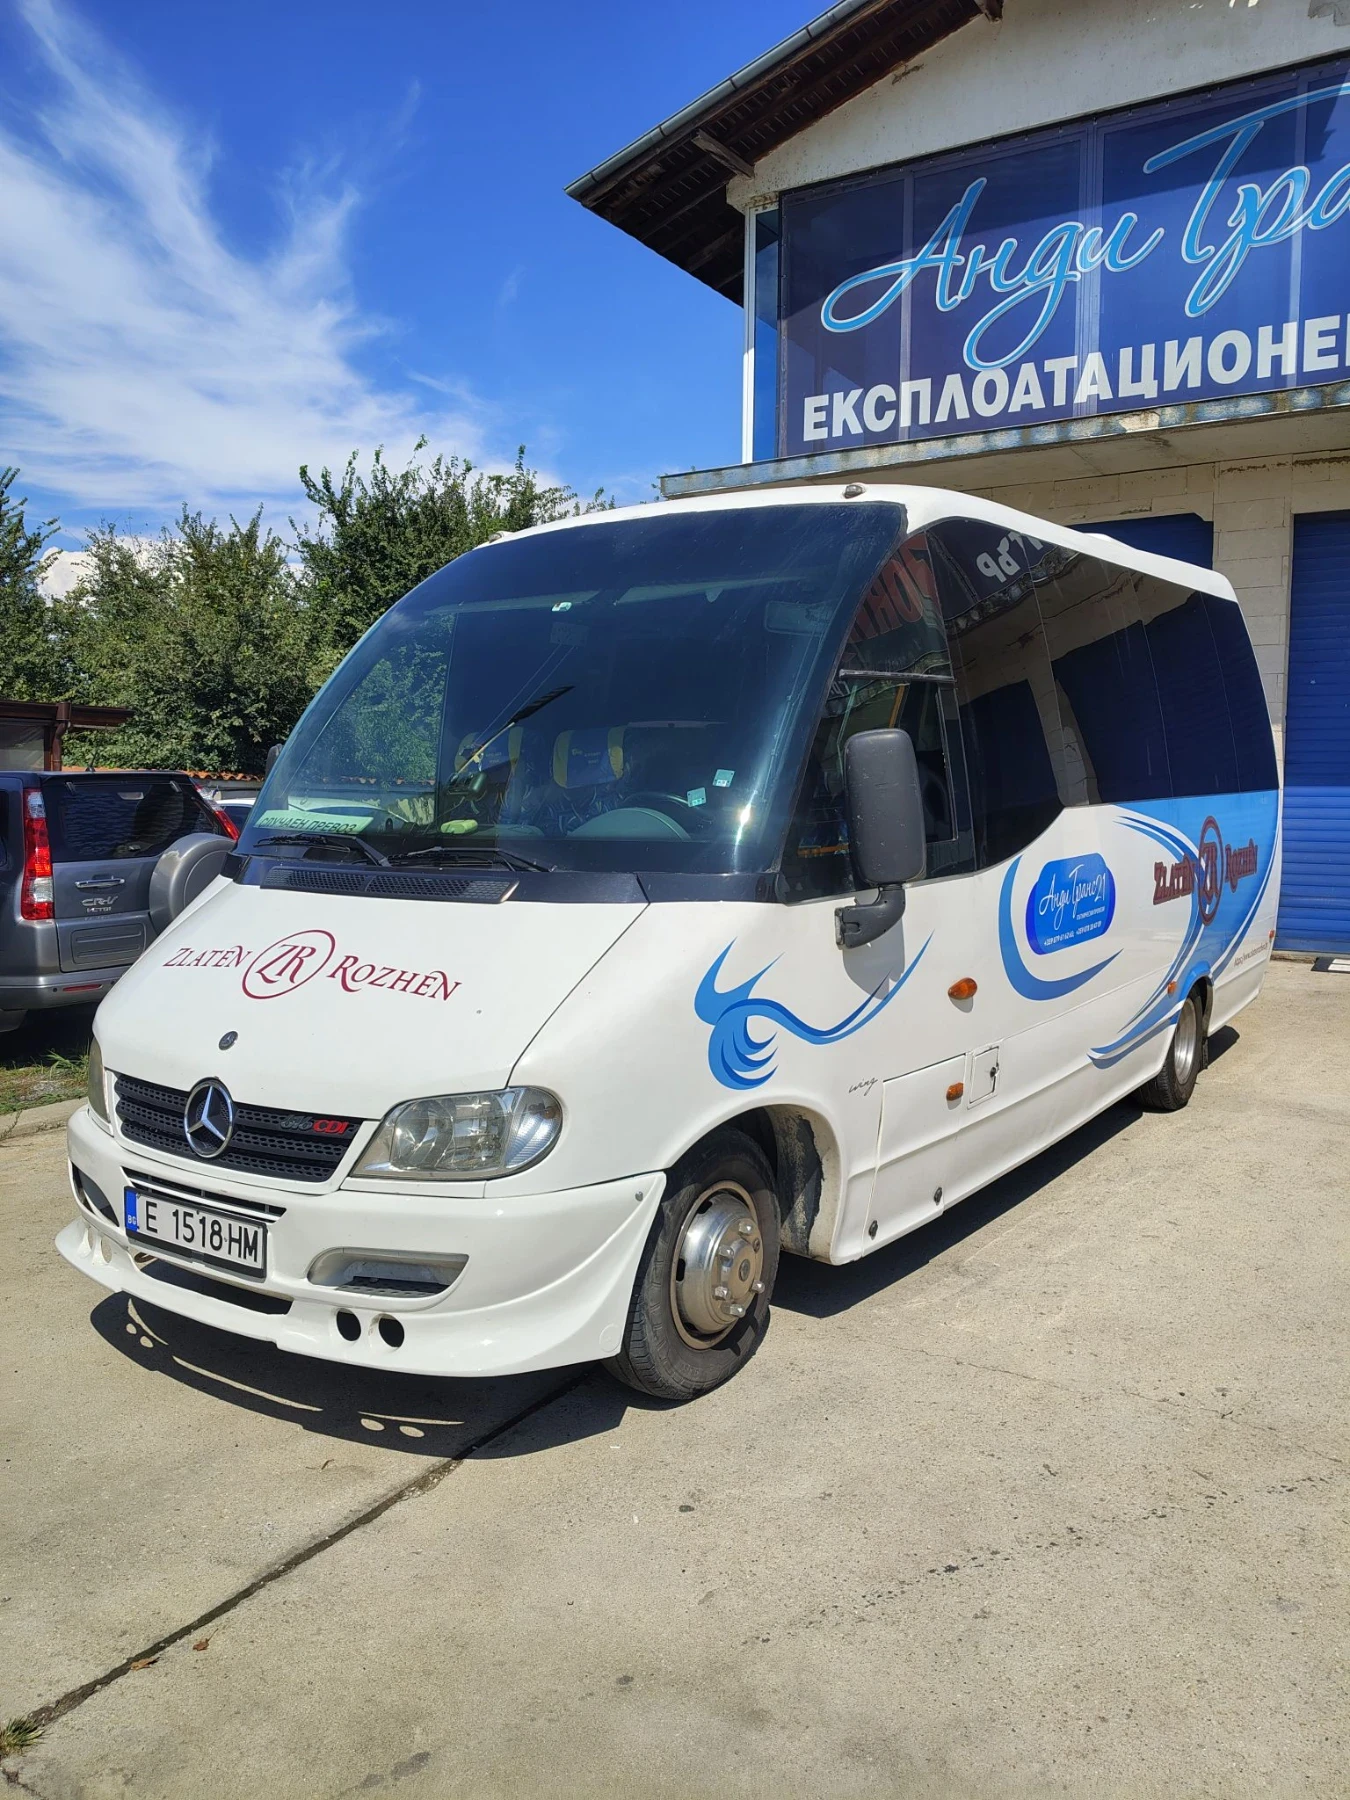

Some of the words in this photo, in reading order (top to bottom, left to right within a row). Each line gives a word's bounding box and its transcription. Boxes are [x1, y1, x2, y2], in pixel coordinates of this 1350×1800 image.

[821, 177, 1164, 371] Анди
[803, 312, 1350, 442] ЕКСПЛОАТАЦИОНЕ
[127, 1214, 137, 1225] BG
